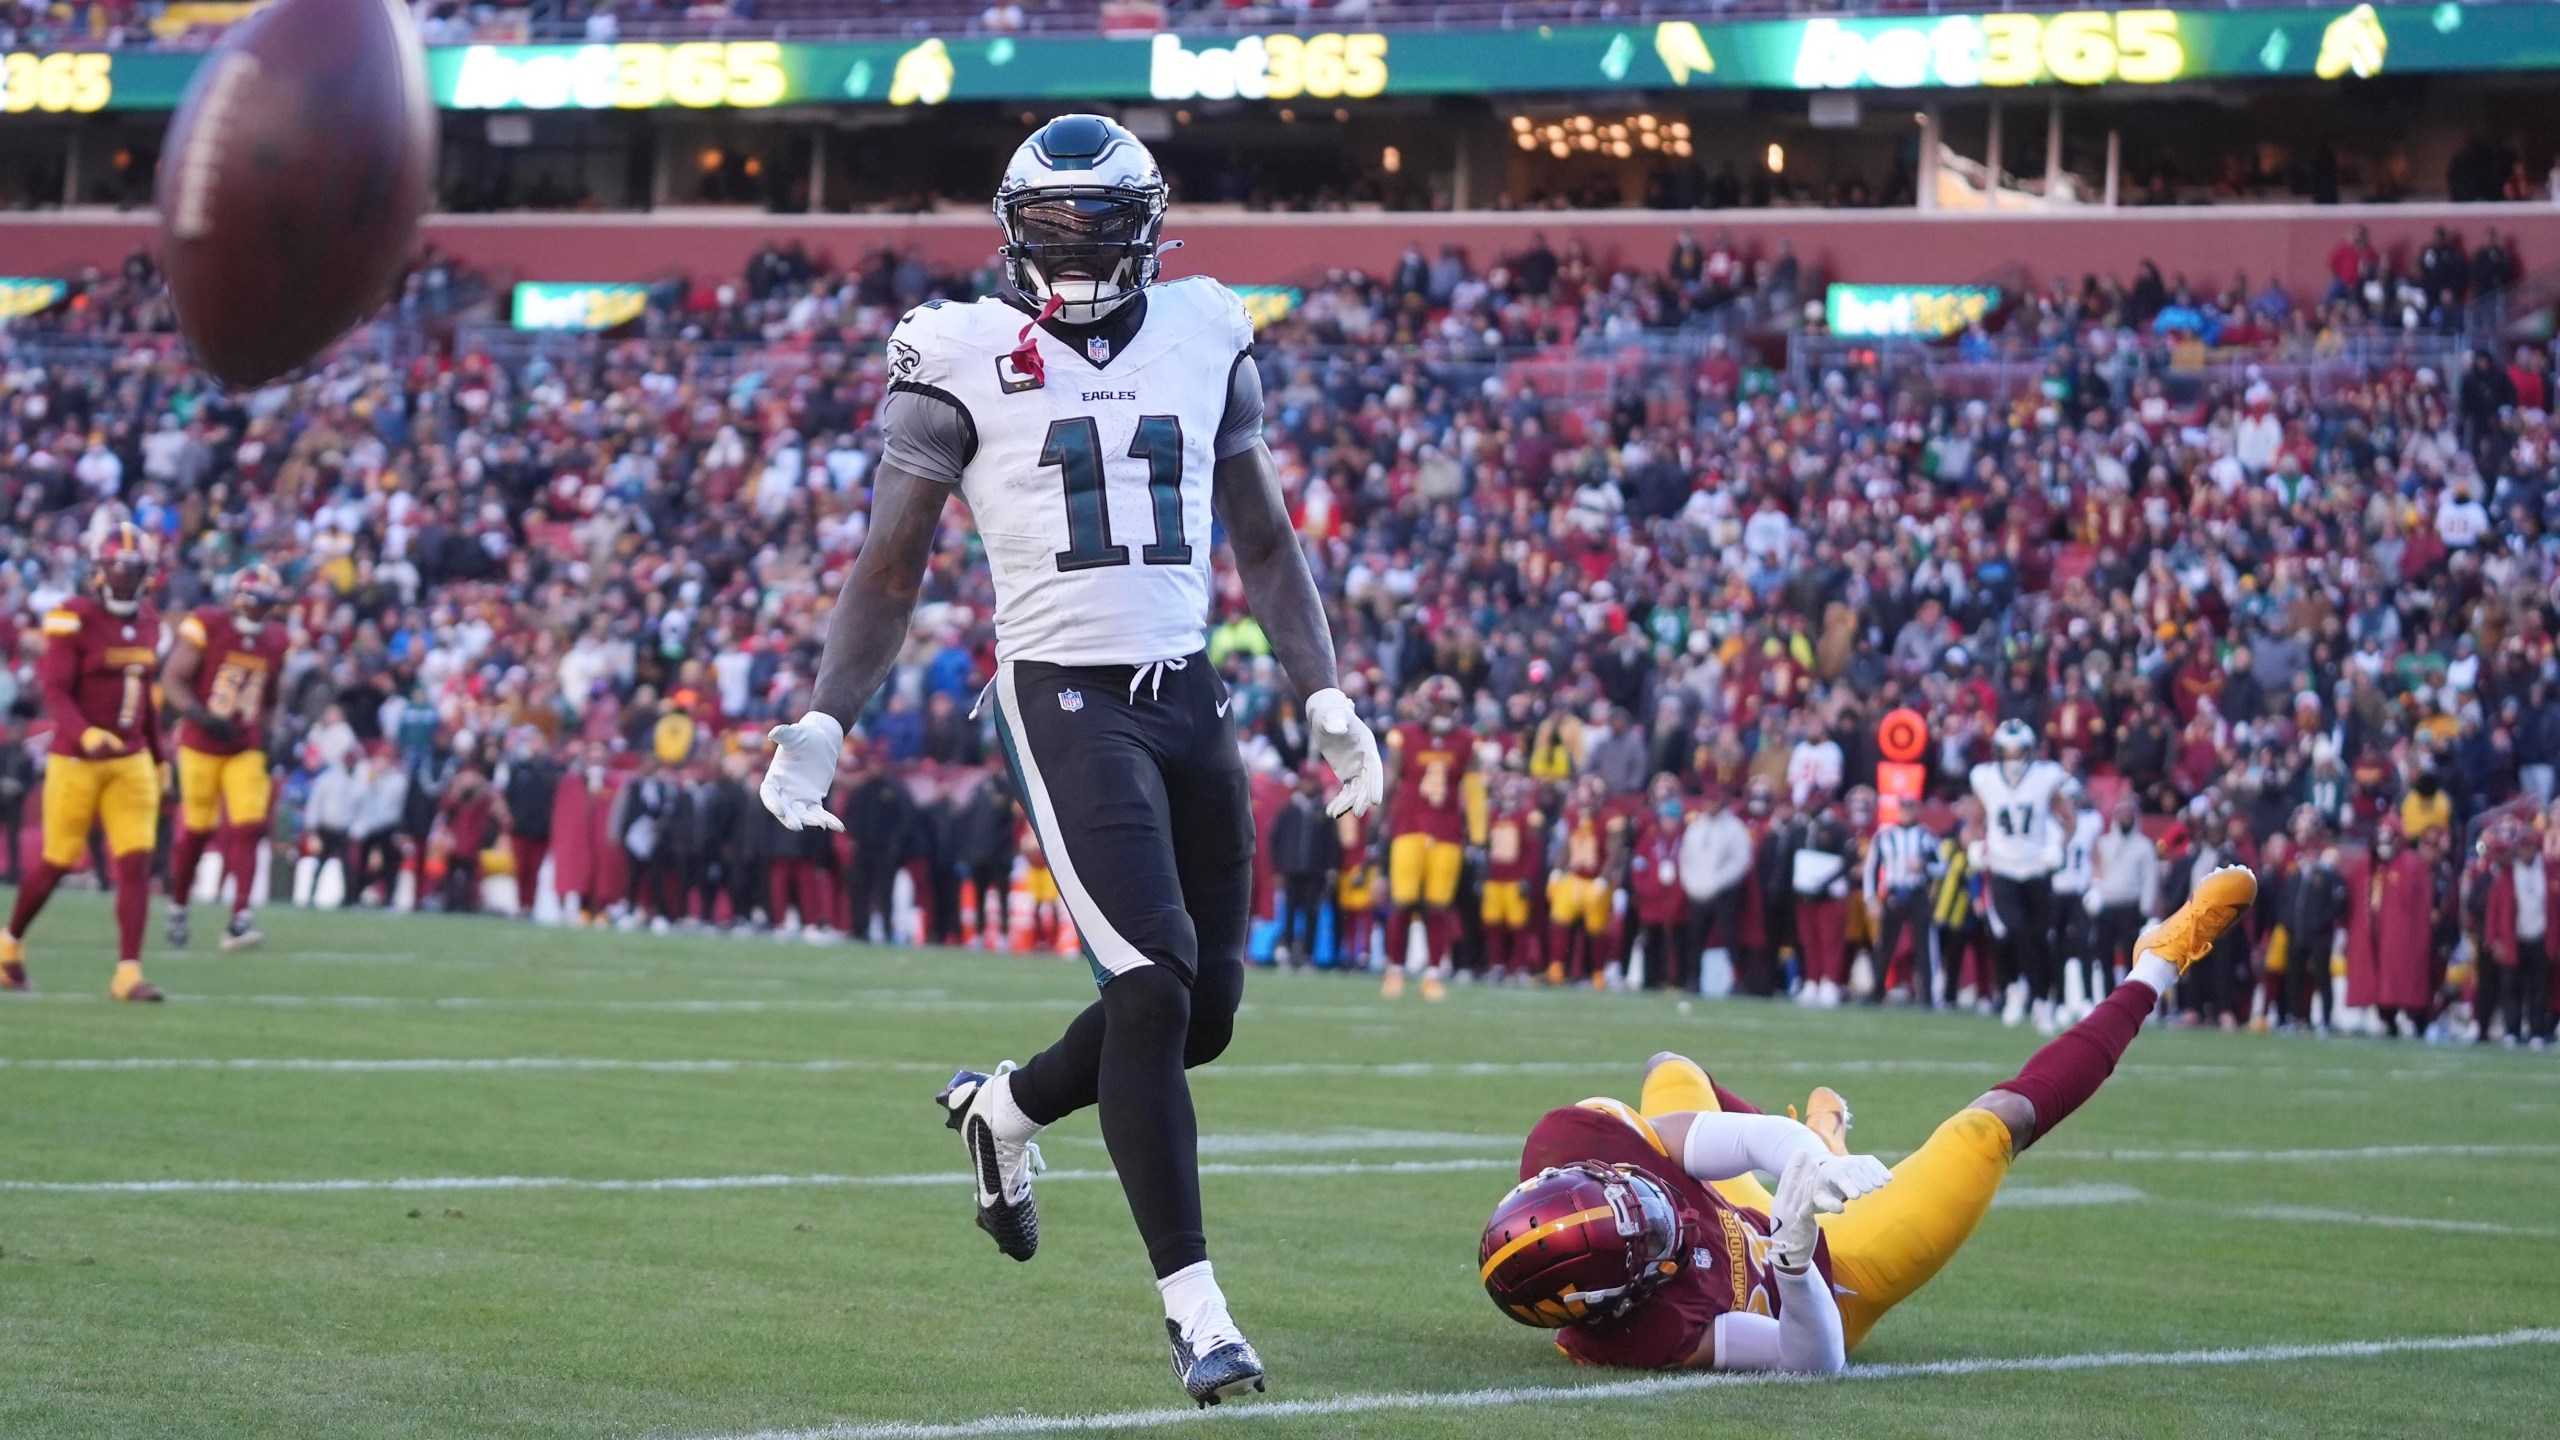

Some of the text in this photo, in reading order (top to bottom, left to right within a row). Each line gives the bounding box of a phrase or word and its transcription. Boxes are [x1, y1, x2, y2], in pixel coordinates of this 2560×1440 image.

[452, 42, 788, 109] bet365
[1151, 33, 1389, 99] bet365
[1793, 9, 2185, 88] bet365
[0, 52, 112, 113] 365
[524, 287, 647, 330] bet
[1838, 290, 1988, 334] bet
[1082, 391, 1136, 401] EAGLES
[1038, 414, 1193, 573] 11
[118, 664, 144, 728] 1
[1998, 802, 2034, 836] 47
[1718, 1208, 1745, 1311] OMMANDERS
